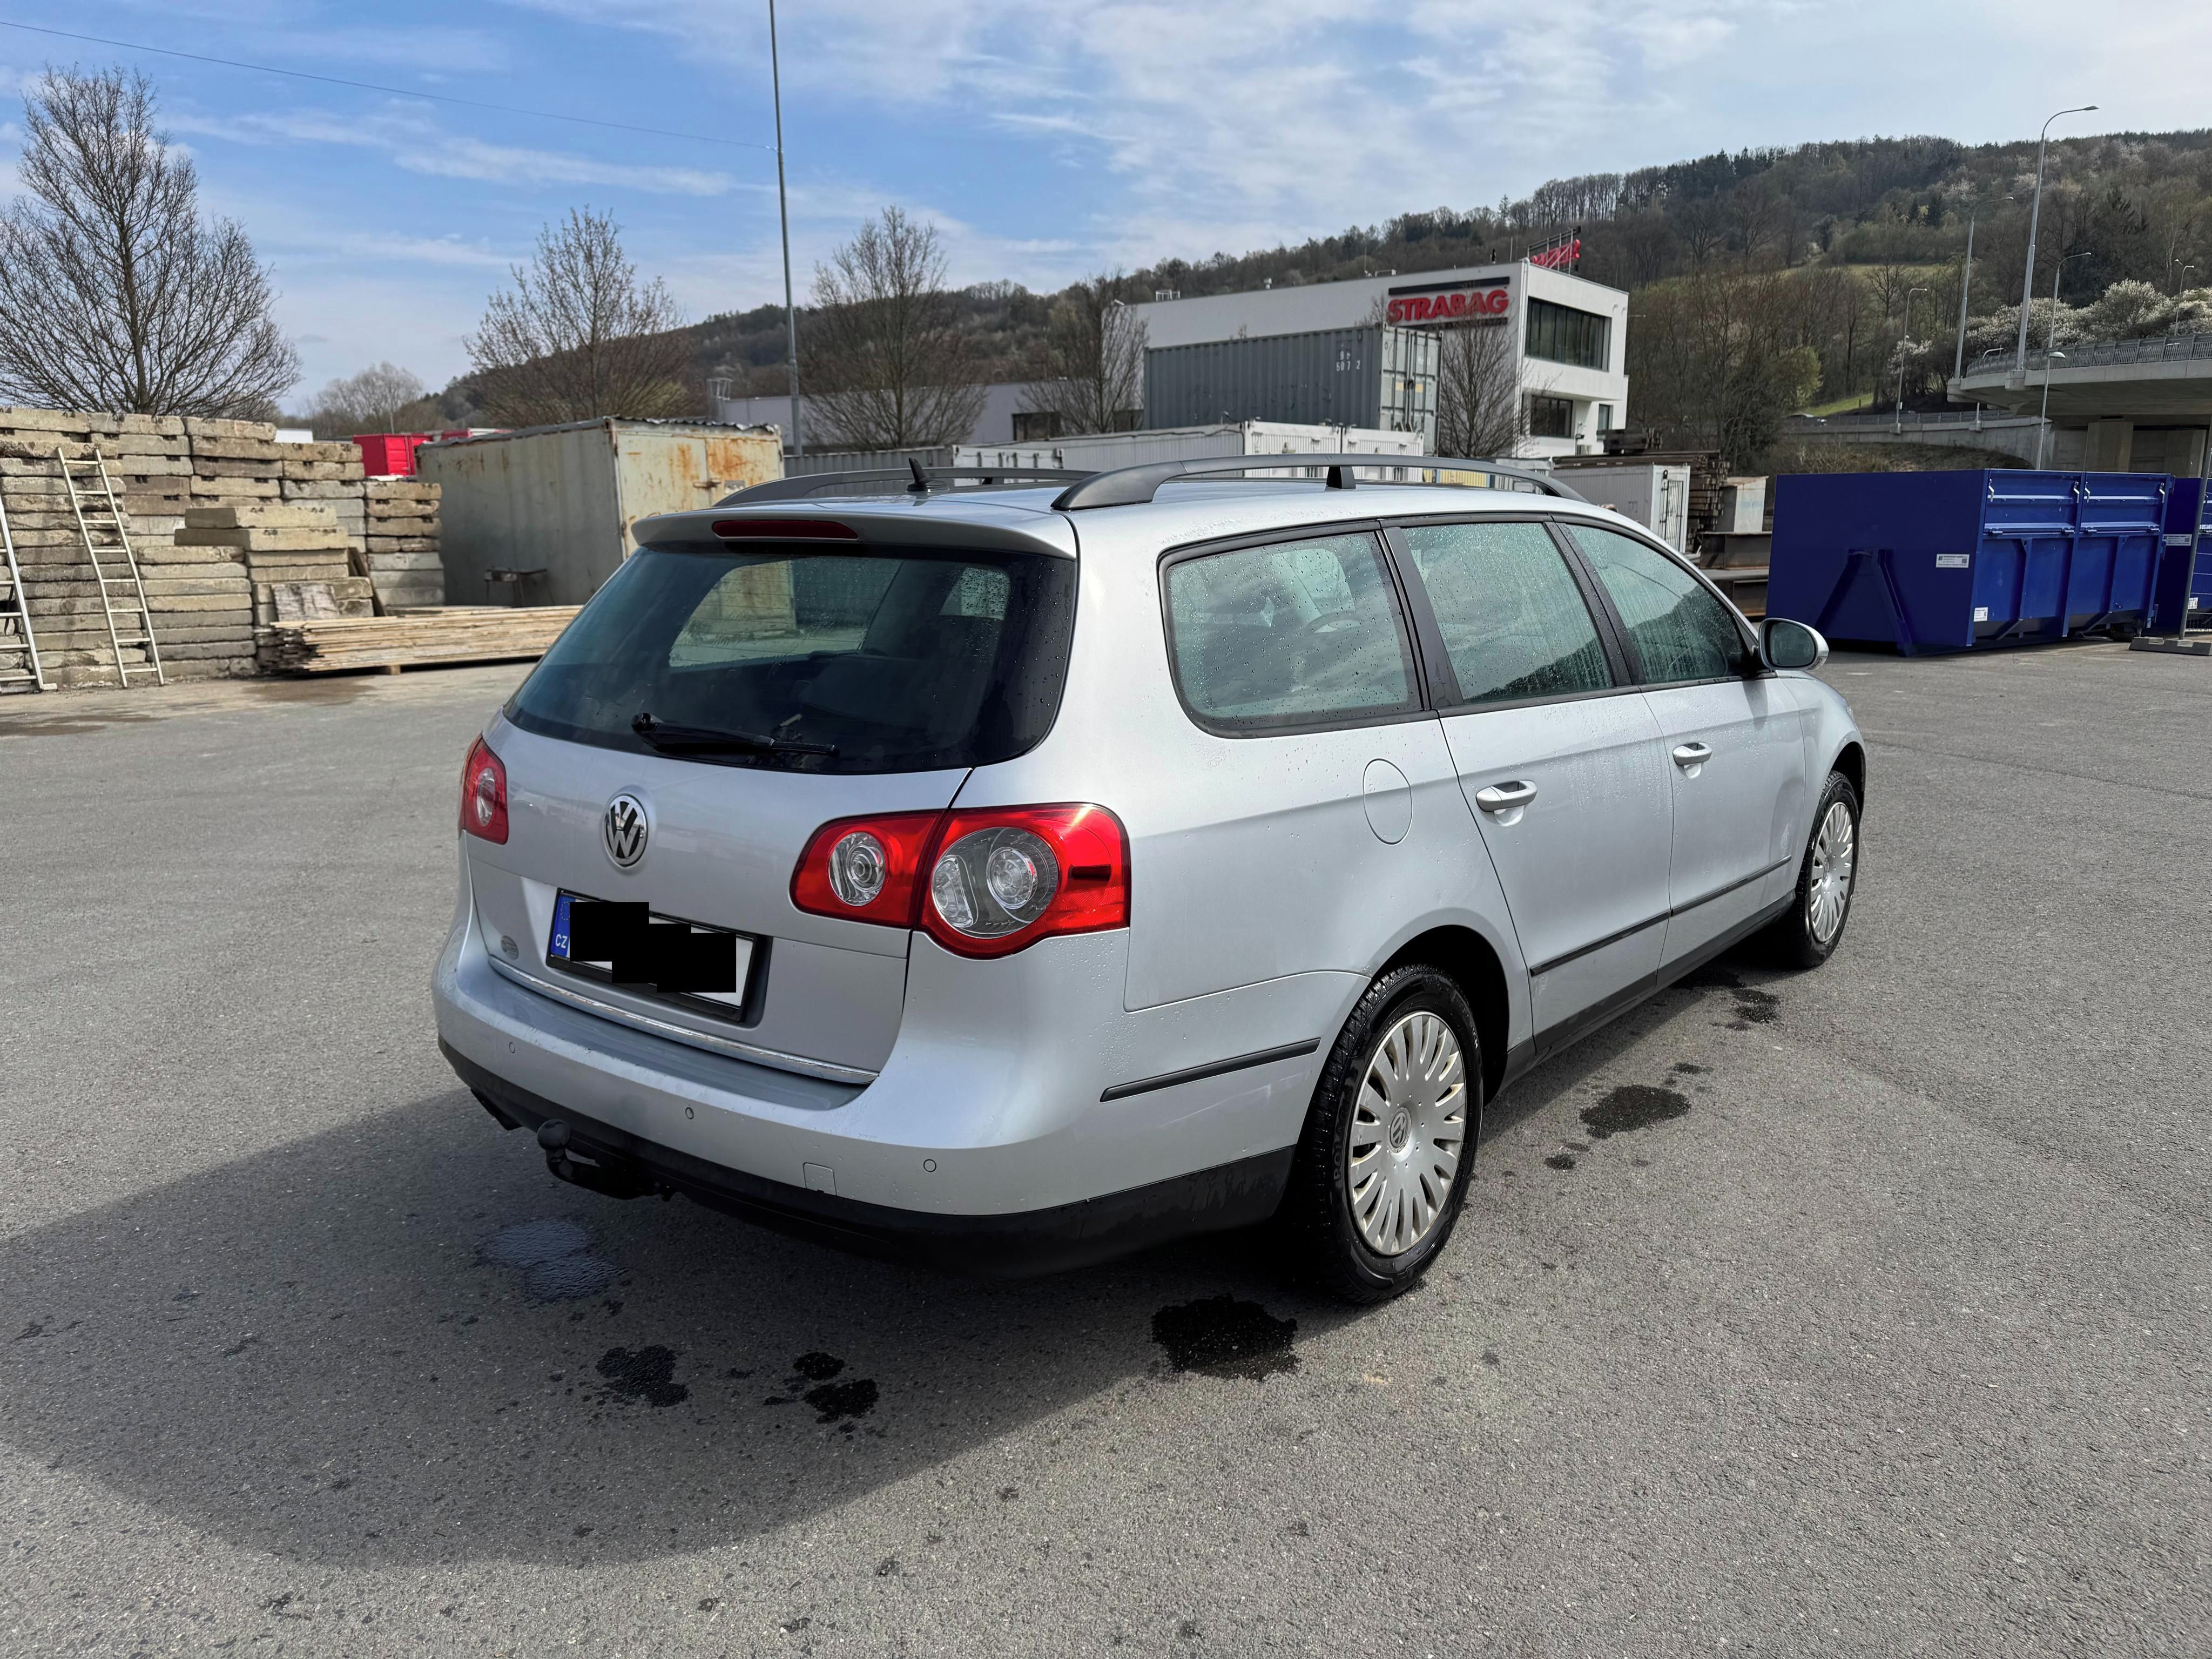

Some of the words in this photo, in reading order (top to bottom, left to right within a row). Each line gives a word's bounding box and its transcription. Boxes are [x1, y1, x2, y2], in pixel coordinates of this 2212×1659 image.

[1387, 289, 1510, 323] STRABAG
[606, 798, 644, 862] VW
[555, 934, 568, 949] CZ
